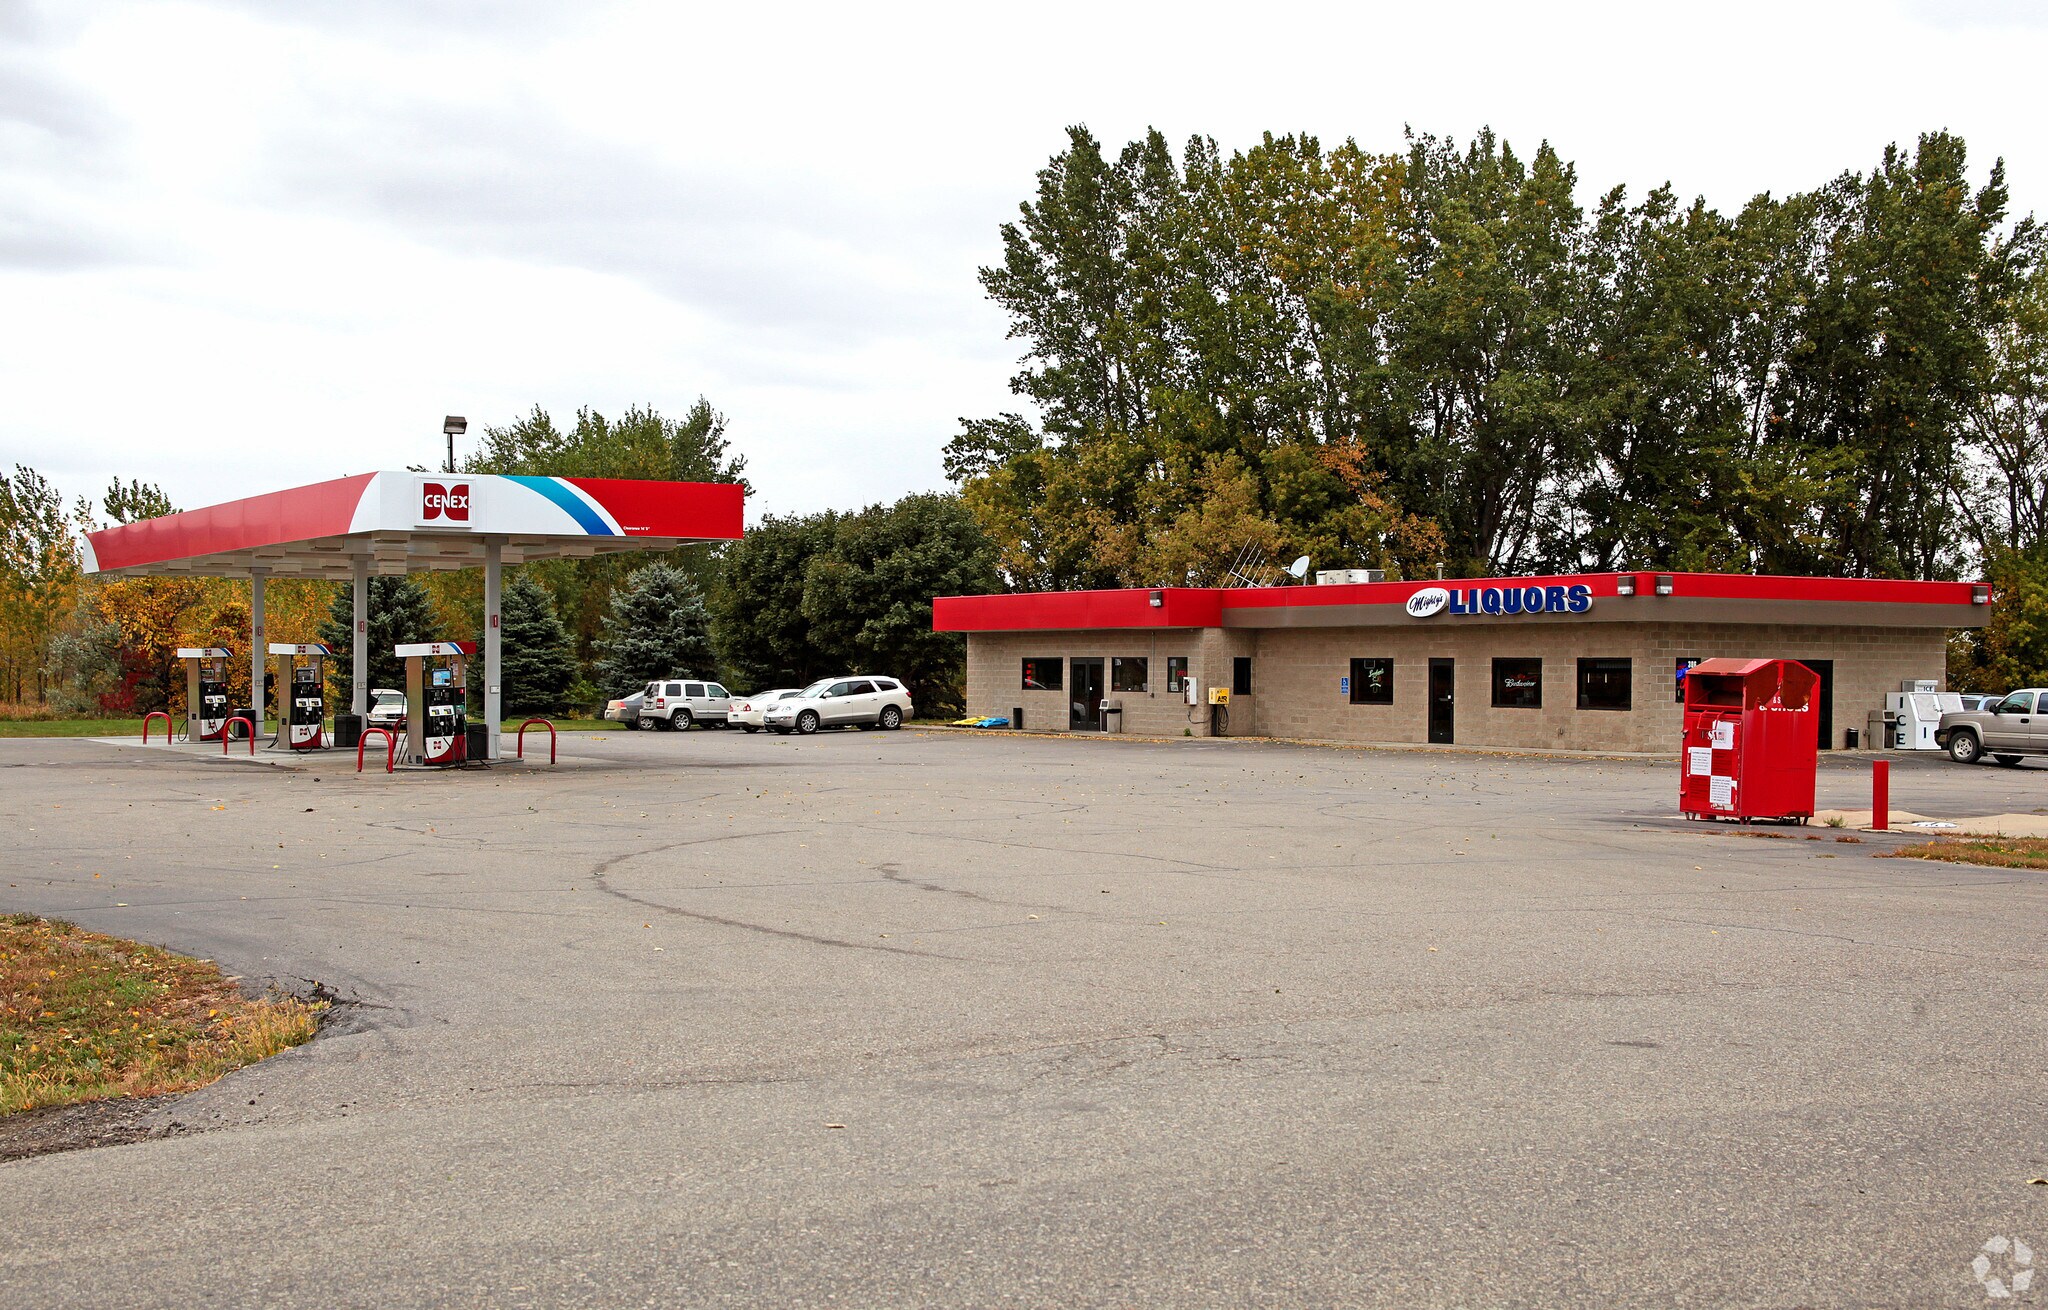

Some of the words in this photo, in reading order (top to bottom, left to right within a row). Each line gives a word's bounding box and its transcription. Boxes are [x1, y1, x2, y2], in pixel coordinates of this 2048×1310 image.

[424, 494, 468, 509] CENEX
[1409, 594, 1444, 613] Mighty's
[1449, 584, 1592, 616] LIQUORS
[1217, 695, 1228, 703] AIR
[1896, 696, 1907, 745] ICE
